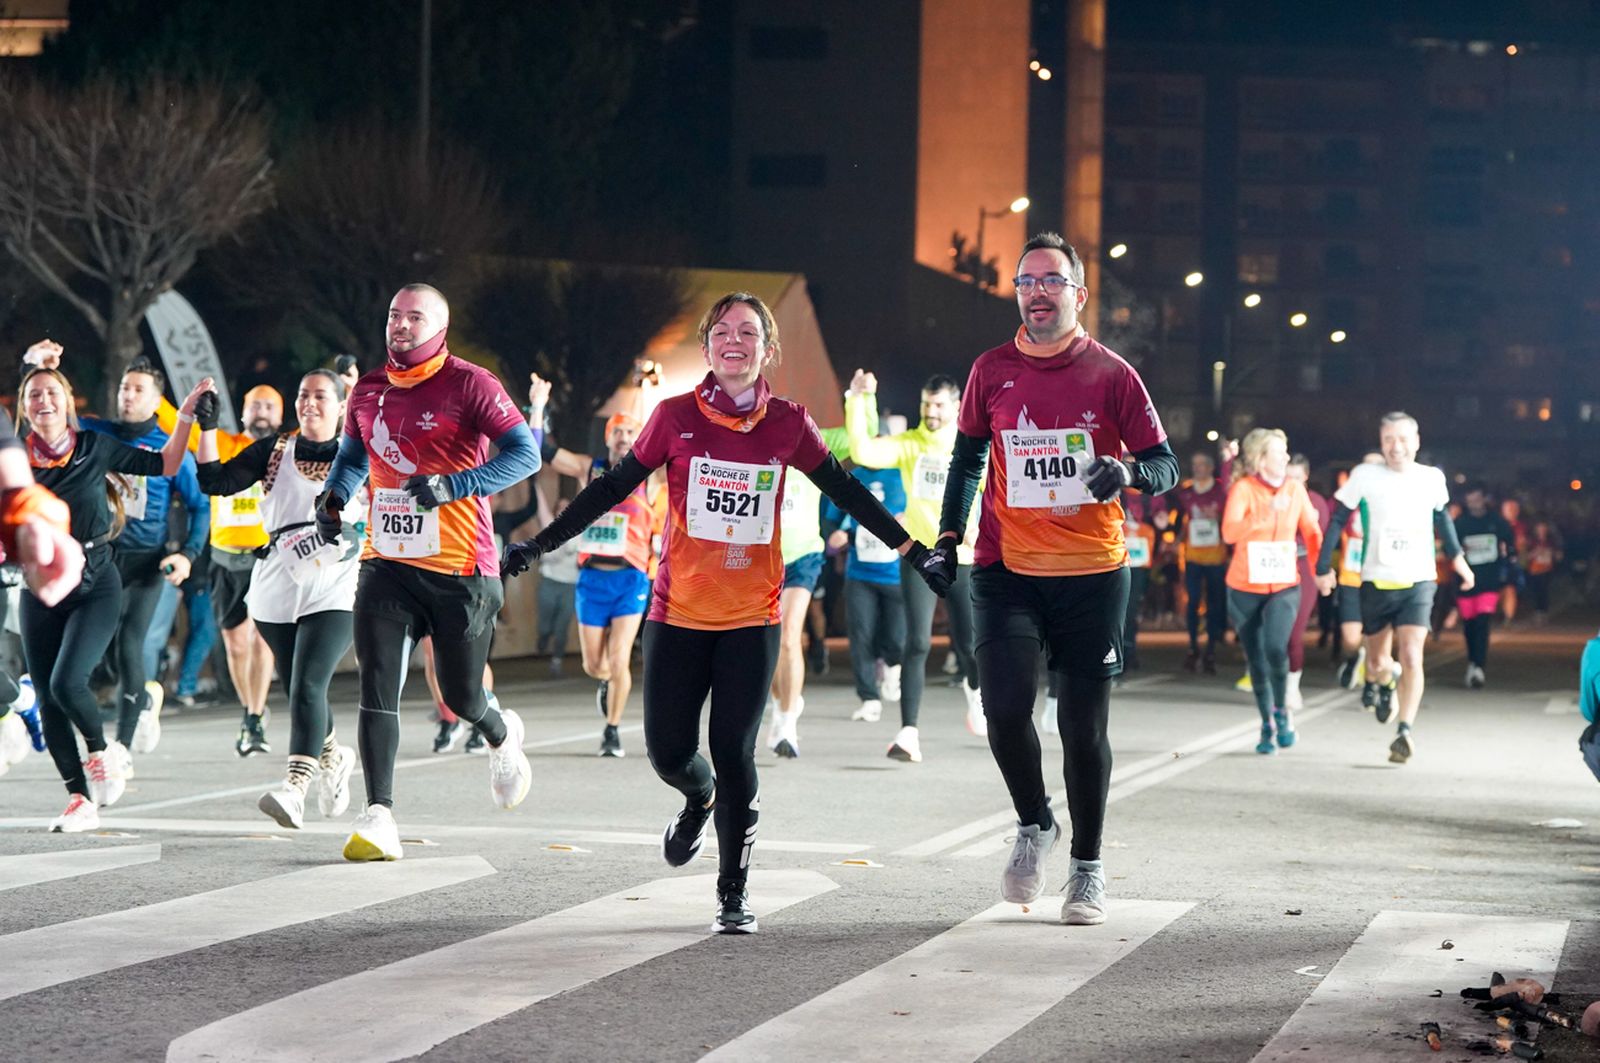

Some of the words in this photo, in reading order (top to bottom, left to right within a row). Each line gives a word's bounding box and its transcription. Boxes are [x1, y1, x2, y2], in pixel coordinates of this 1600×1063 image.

[1021, 438, 1047, 446] NOCHE
[1048, 437, 1058, 445] DE
[383, 446, 400, 464] 43
[1013, 448, 1029, 456] SAN
[711, 468, 738, 480] NOCHE
[738, 472, 750, 481] DE
[1024, 456, 1077, 481] 4140
[698, 476, 717, 487] SAN
[718, 479, 749, 491] ANTÓN
[925, 471, 945, 484] 498
[705, 488, 761, 517] 5521
[382, 513, 424, 535] 2637
